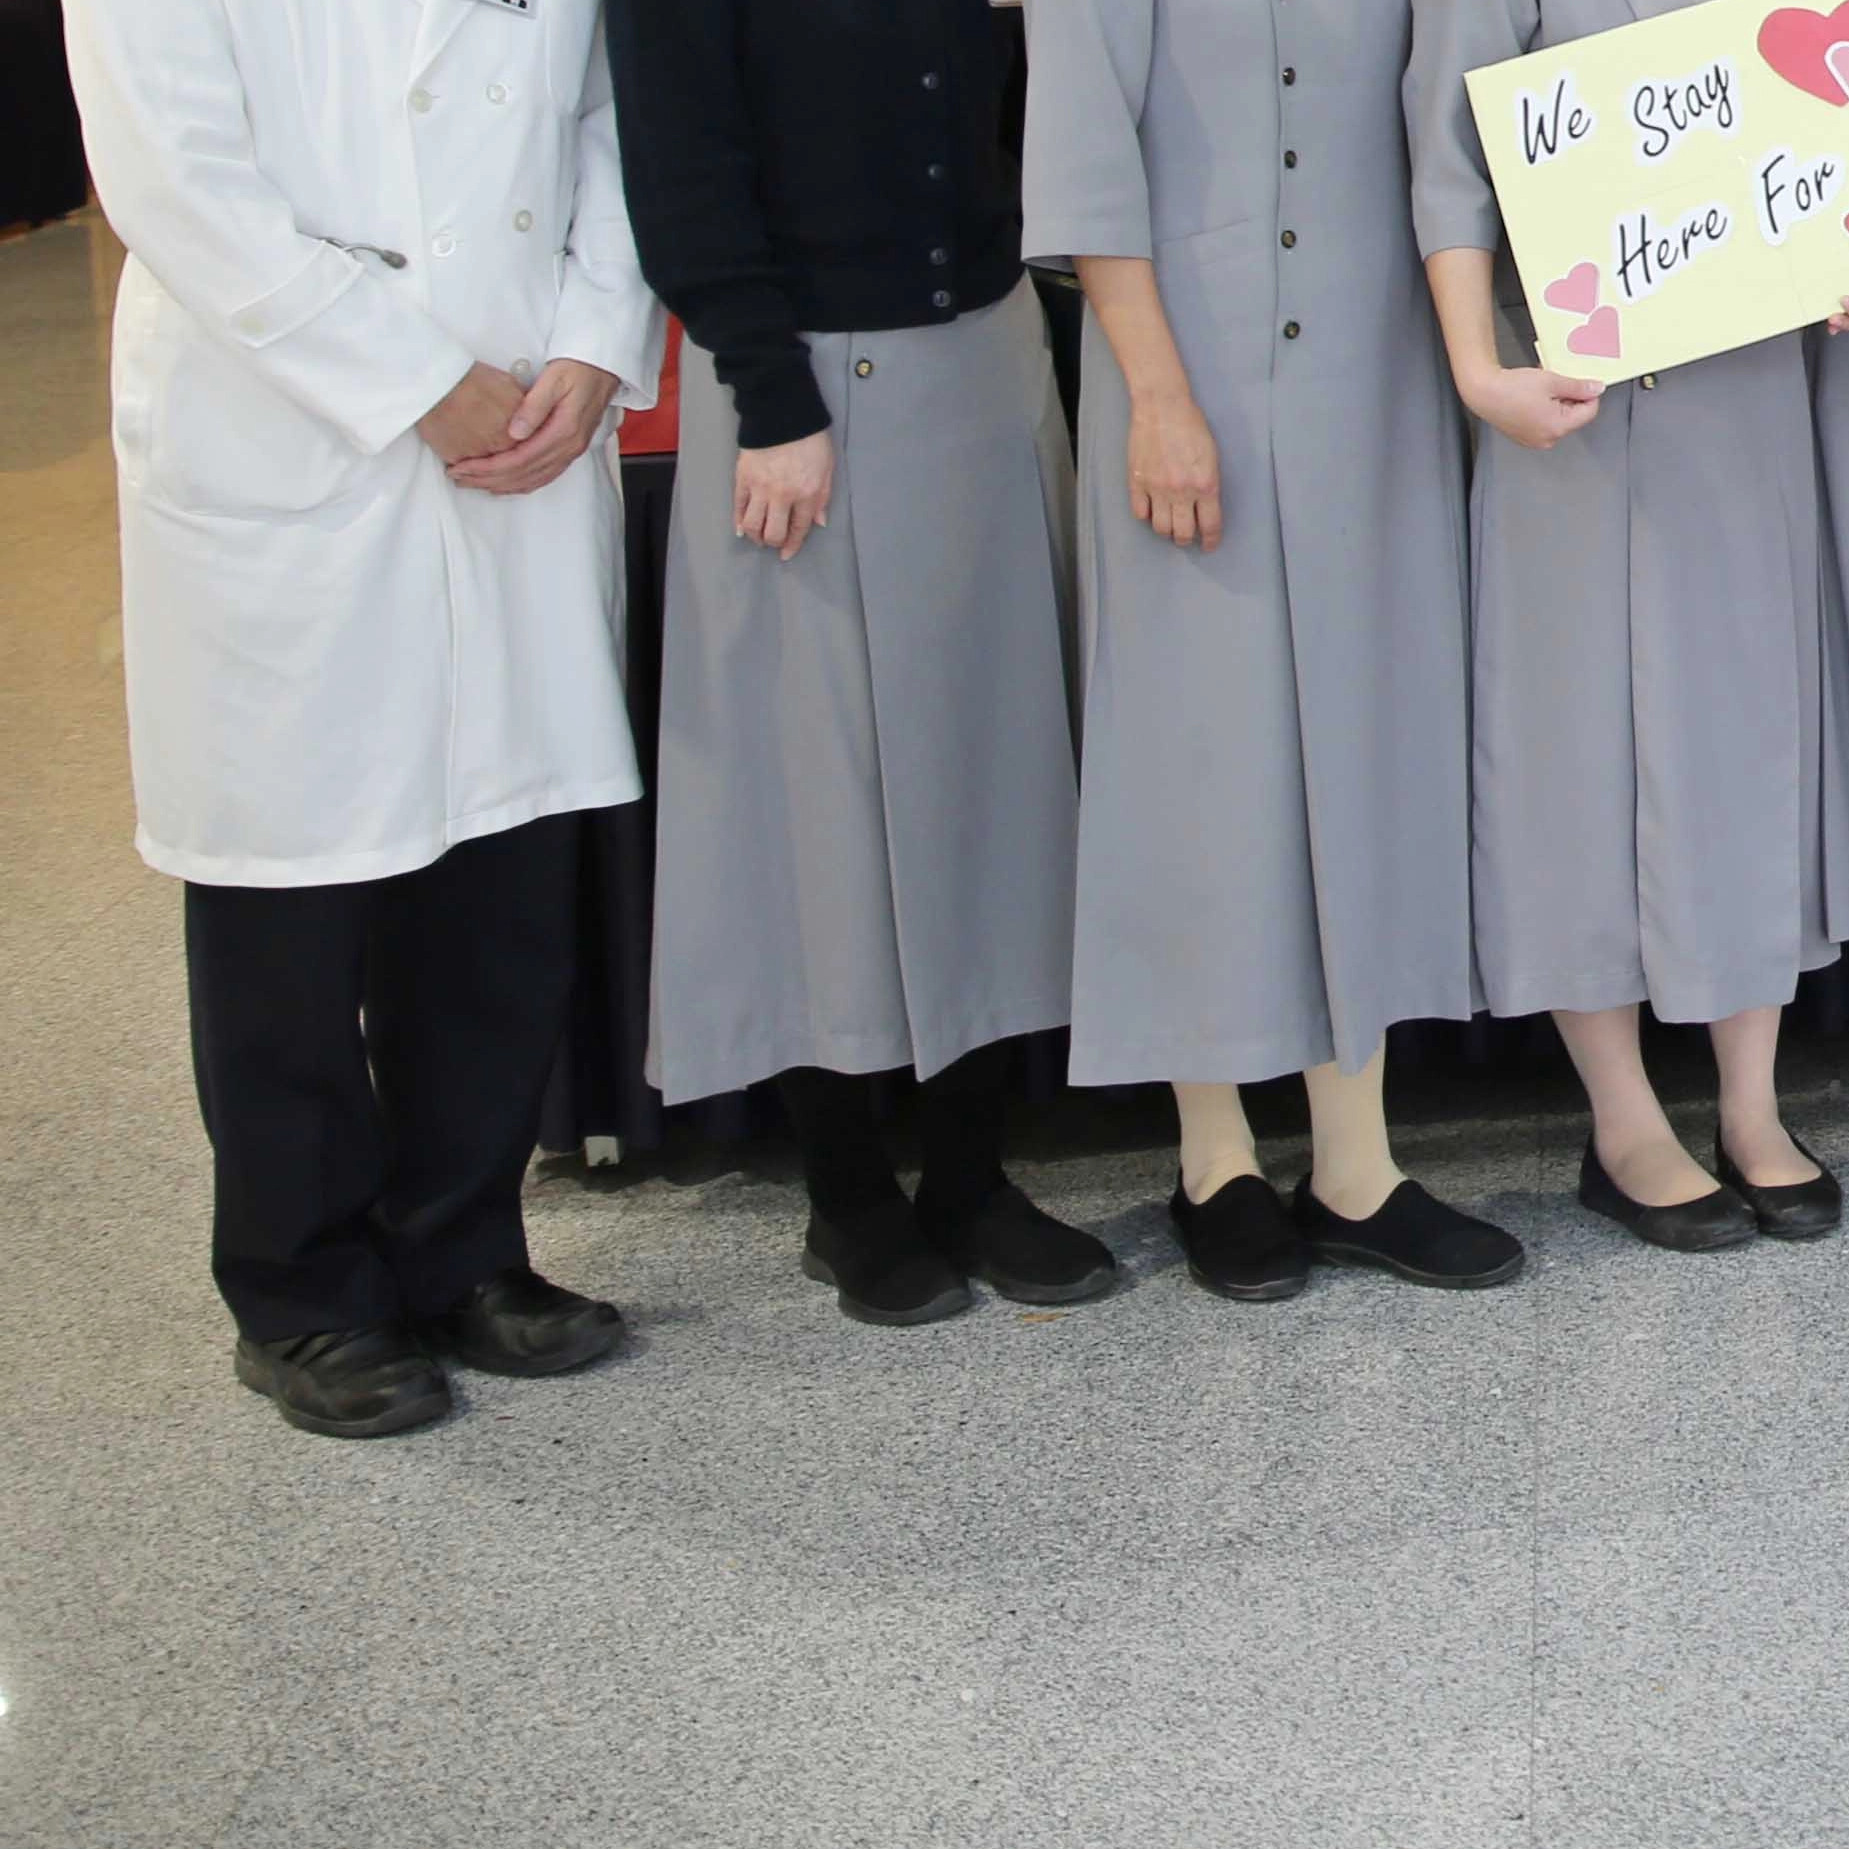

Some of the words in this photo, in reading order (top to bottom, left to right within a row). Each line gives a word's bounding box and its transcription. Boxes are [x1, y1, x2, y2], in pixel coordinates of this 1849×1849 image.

[1523, 80, 1591, 164] We
[1633, 63, 1730, 157] Stay
[1616, 207, 1728, 298] Here
[1761, 155, 1835, 232] For
